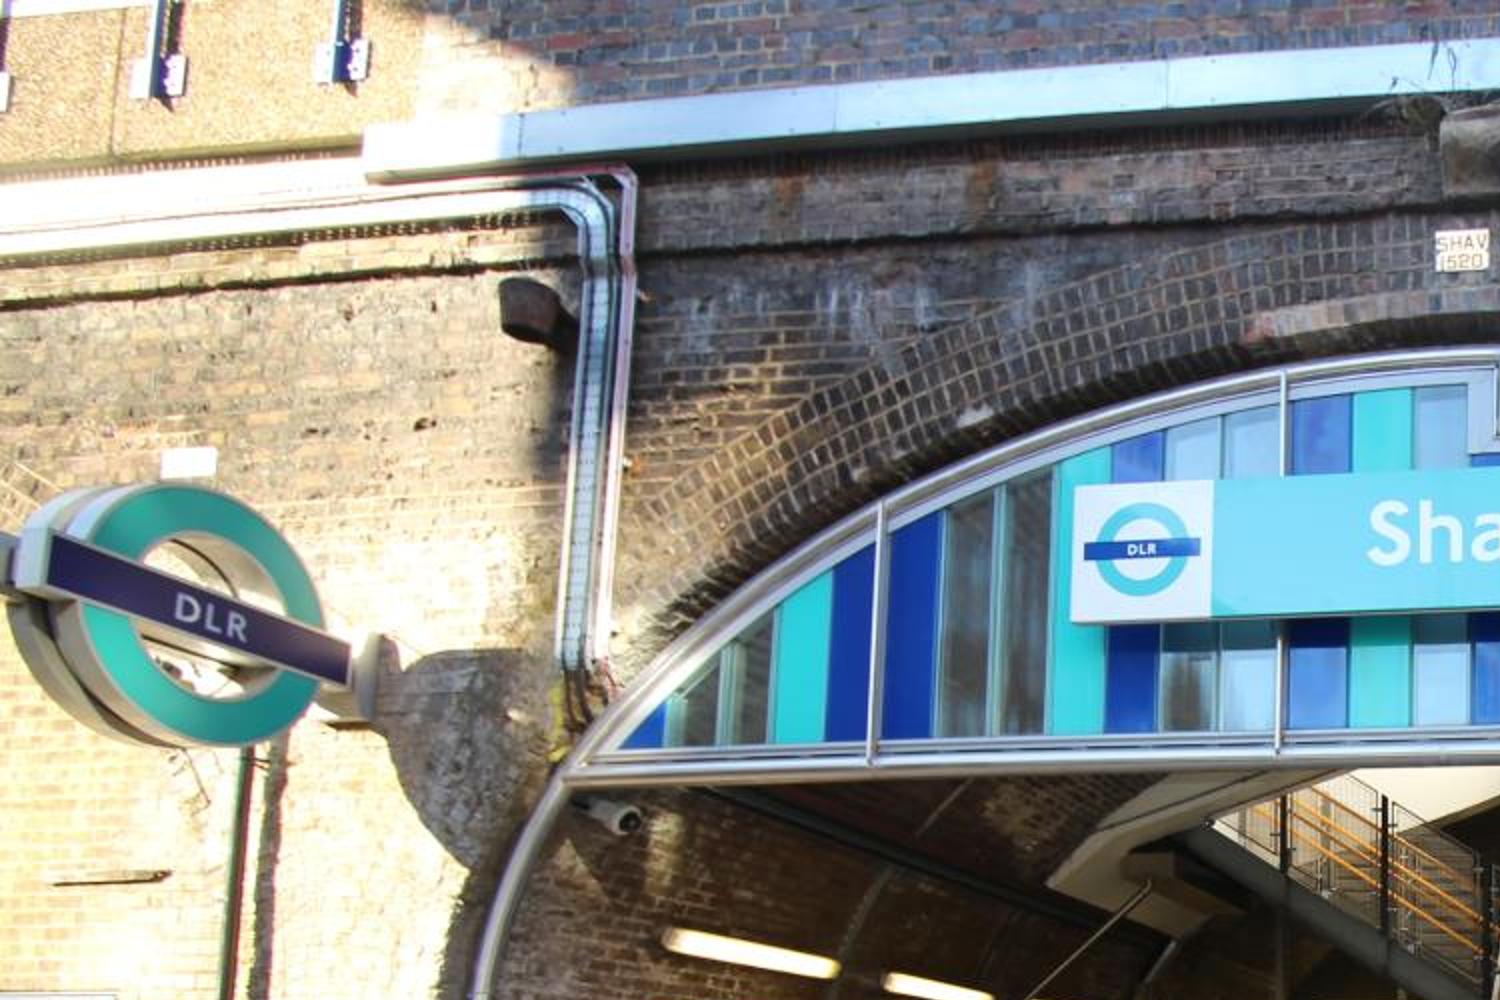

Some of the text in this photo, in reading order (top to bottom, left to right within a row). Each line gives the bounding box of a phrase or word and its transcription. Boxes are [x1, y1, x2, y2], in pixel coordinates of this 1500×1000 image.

[1440, 253, 1483, 272] 1520
[1127, 543, 1157, 556] DLR
[174, 591, 248, 644] DLR
